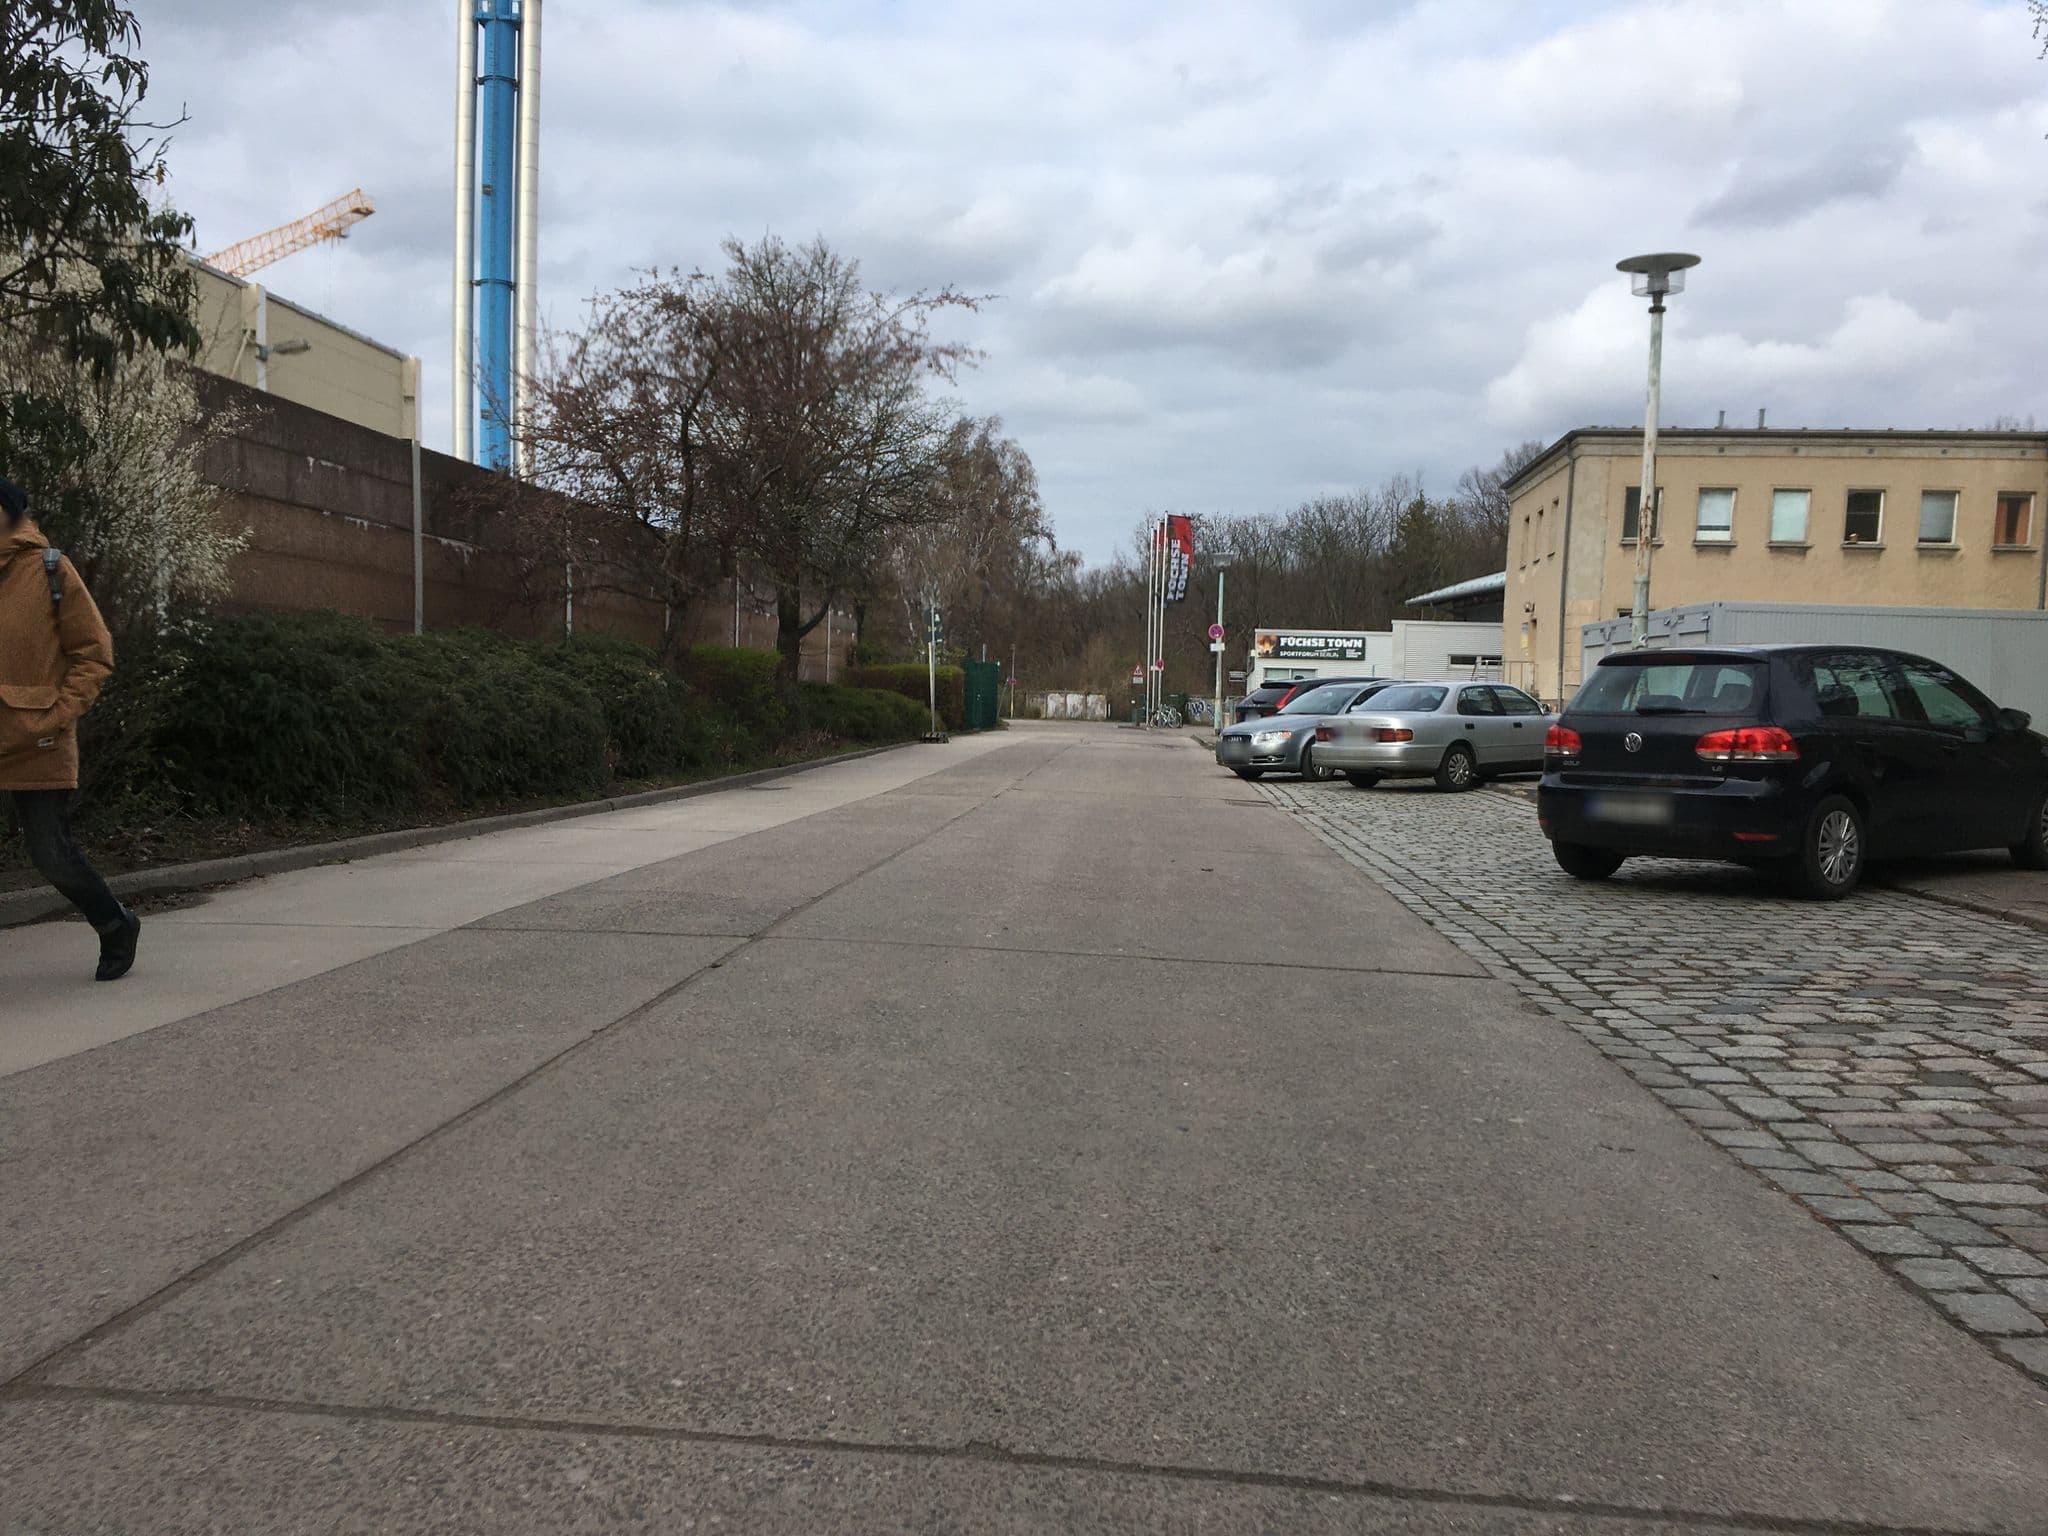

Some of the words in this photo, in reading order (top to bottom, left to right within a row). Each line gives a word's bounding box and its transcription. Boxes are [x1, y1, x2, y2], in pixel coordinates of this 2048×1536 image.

[1166, 539, 1180, 600] FÜCHSE
[1175, 553, 1189, 600] TOWN
[1280, 636, 1325, 647] FÜCHSE
[1327, 638, 1362, 648] TOWN
